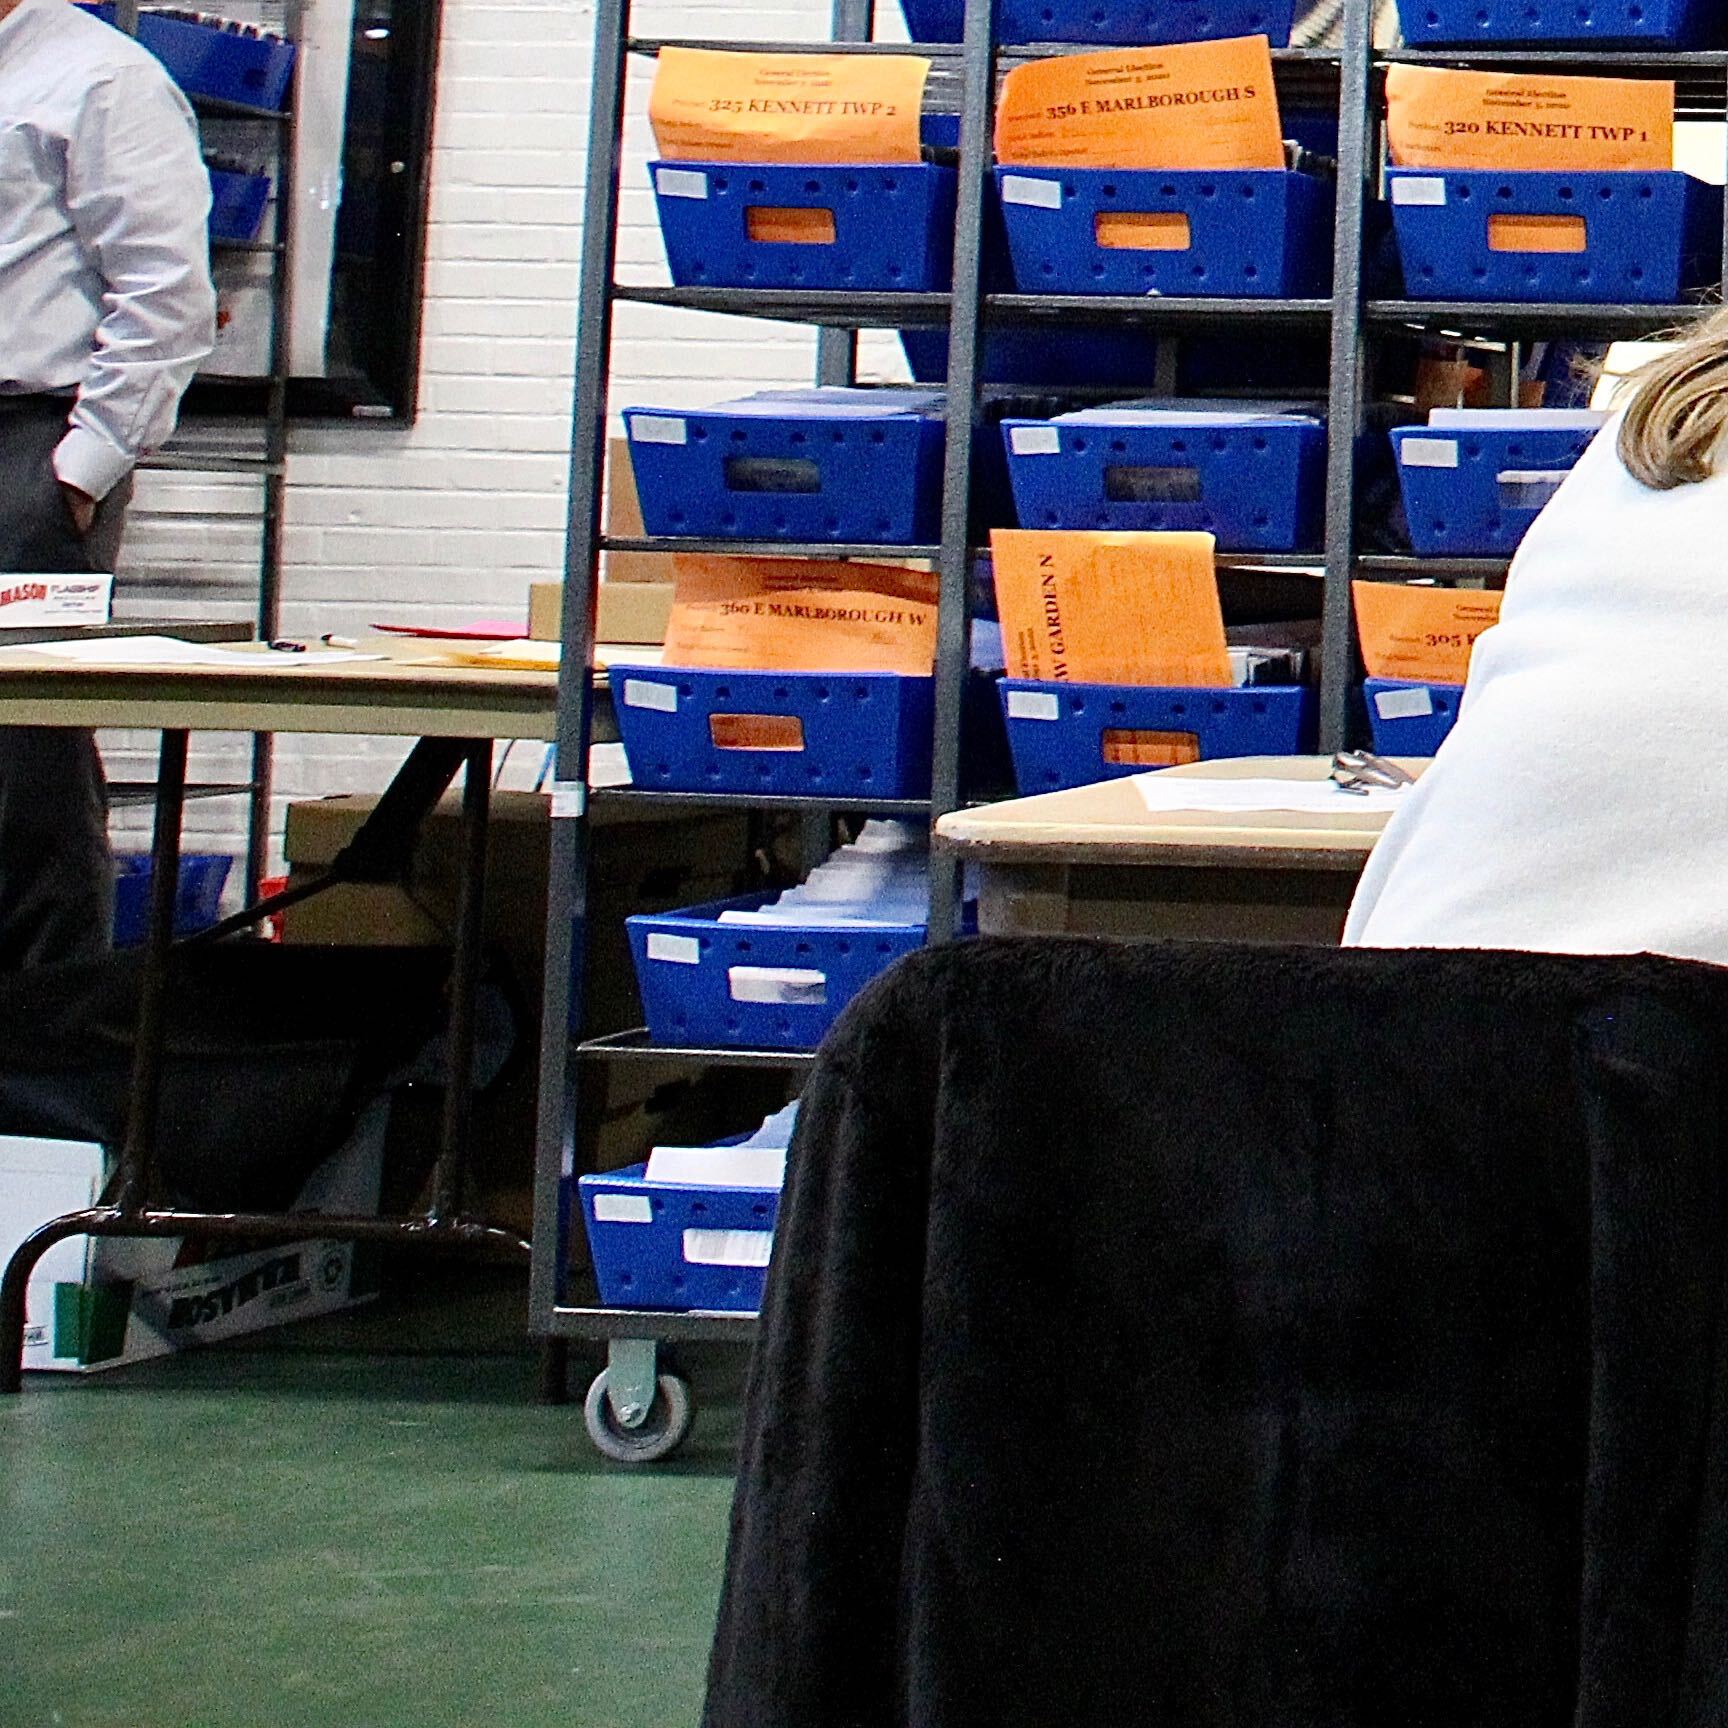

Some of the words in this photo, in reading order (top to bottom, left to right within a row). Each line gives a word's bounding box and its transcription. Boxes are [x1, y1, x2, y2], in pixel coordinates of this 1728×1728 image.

[709, 99, 742, 113] 325
[749, 99, 834, 115] KENNETT
[842, 102, 882, 116] TWP
[886, 106, 896, 116] 2
[1046, 106, 1076, 120] 356
[1080, 101, 1090, 114] E
[1096, 88, 1240, 113] MARLBOROUGH
[1244, 85, 1256, 98] S
[1444, 122, 1479, 134] 320
[1486, 121, 1582, 138] KENNETT
[1588, 126, 1634, 140] TWP
[1640, 132, 1646, 142] 1
[1040, 553, 1053, 567] N
[721, 604, 750, 616] 360
[754, 604, 762, 614] E
[769, 604, 902, 623] MARLBOROUGH
[908, 613, 926, 626] W
[1042, 574, 1064, 655] GARDEN
[1425, 634, 1461, 646] 305
